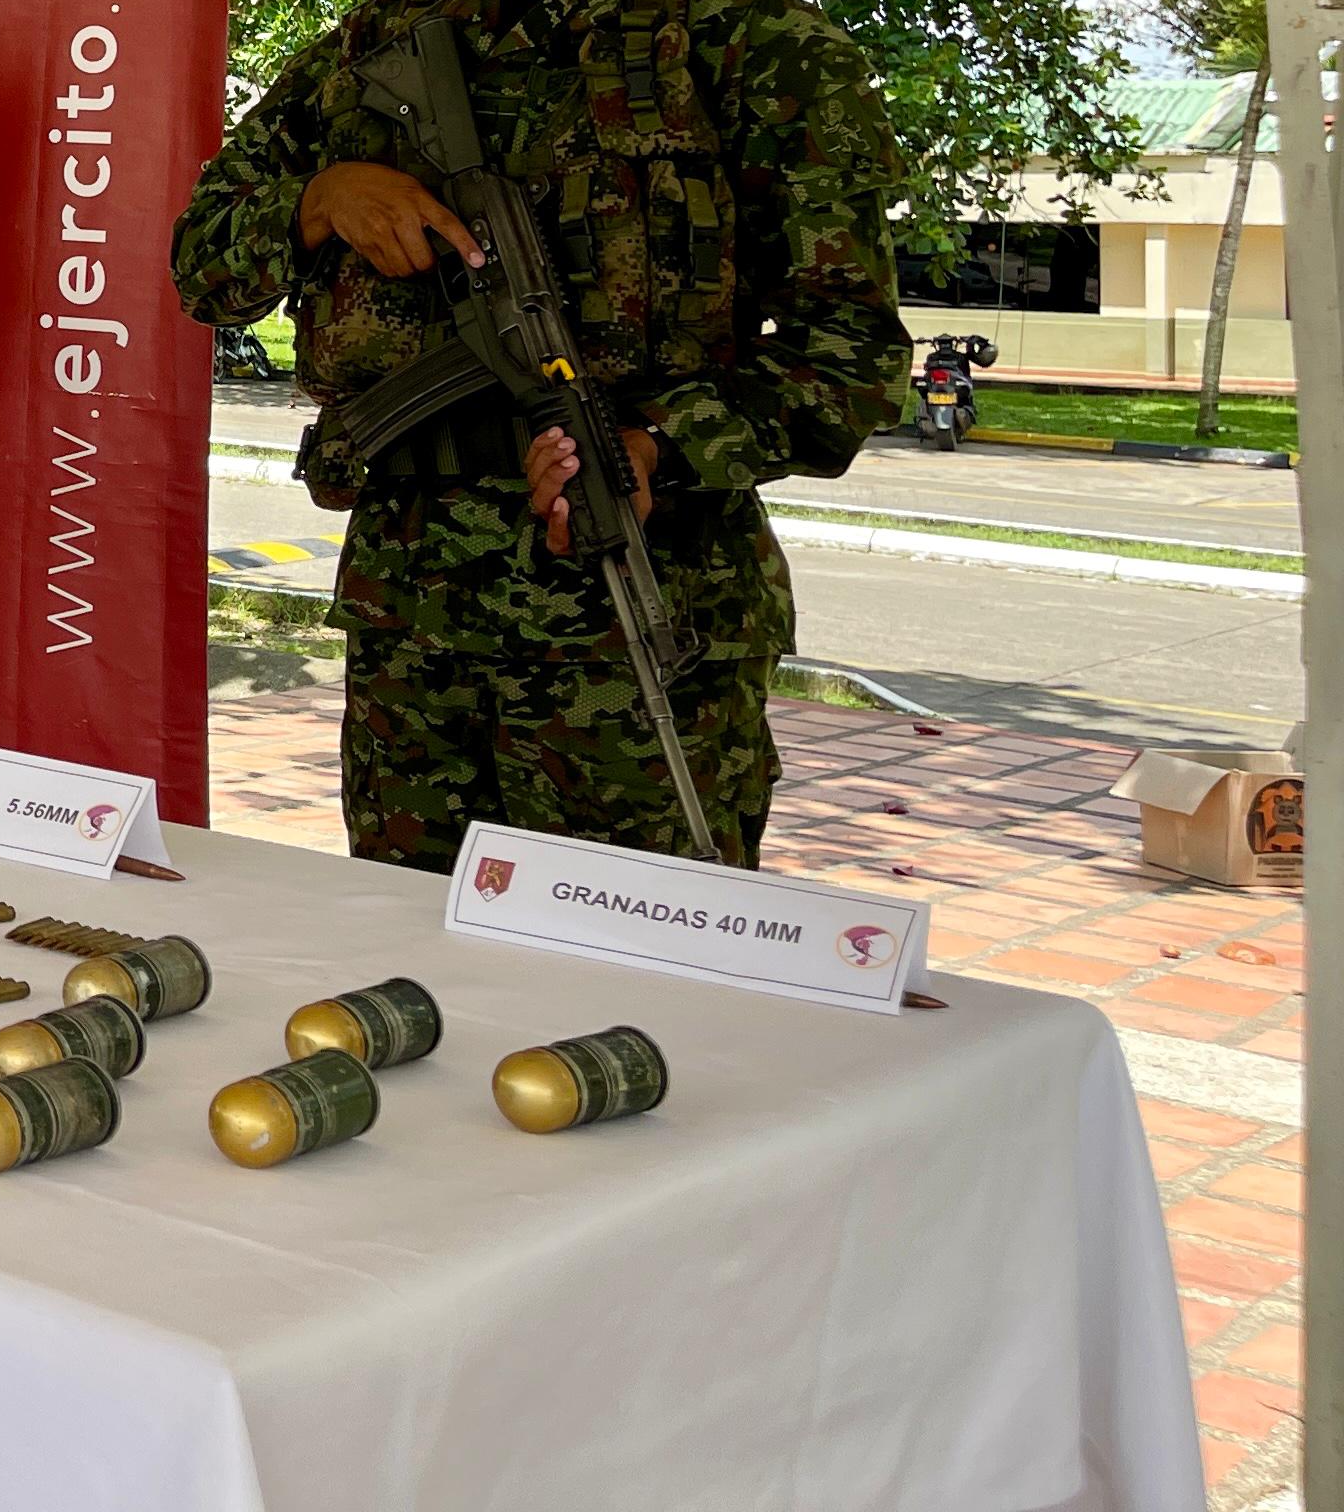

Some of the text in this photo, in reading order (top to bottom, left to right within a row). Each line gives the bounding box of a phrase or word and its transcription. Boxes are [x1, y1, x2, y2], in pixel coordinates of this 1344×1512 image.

[6, 798, 80, 827] 5.56MM
[551, 880, 803, 945] GRANADAS 40 MM
